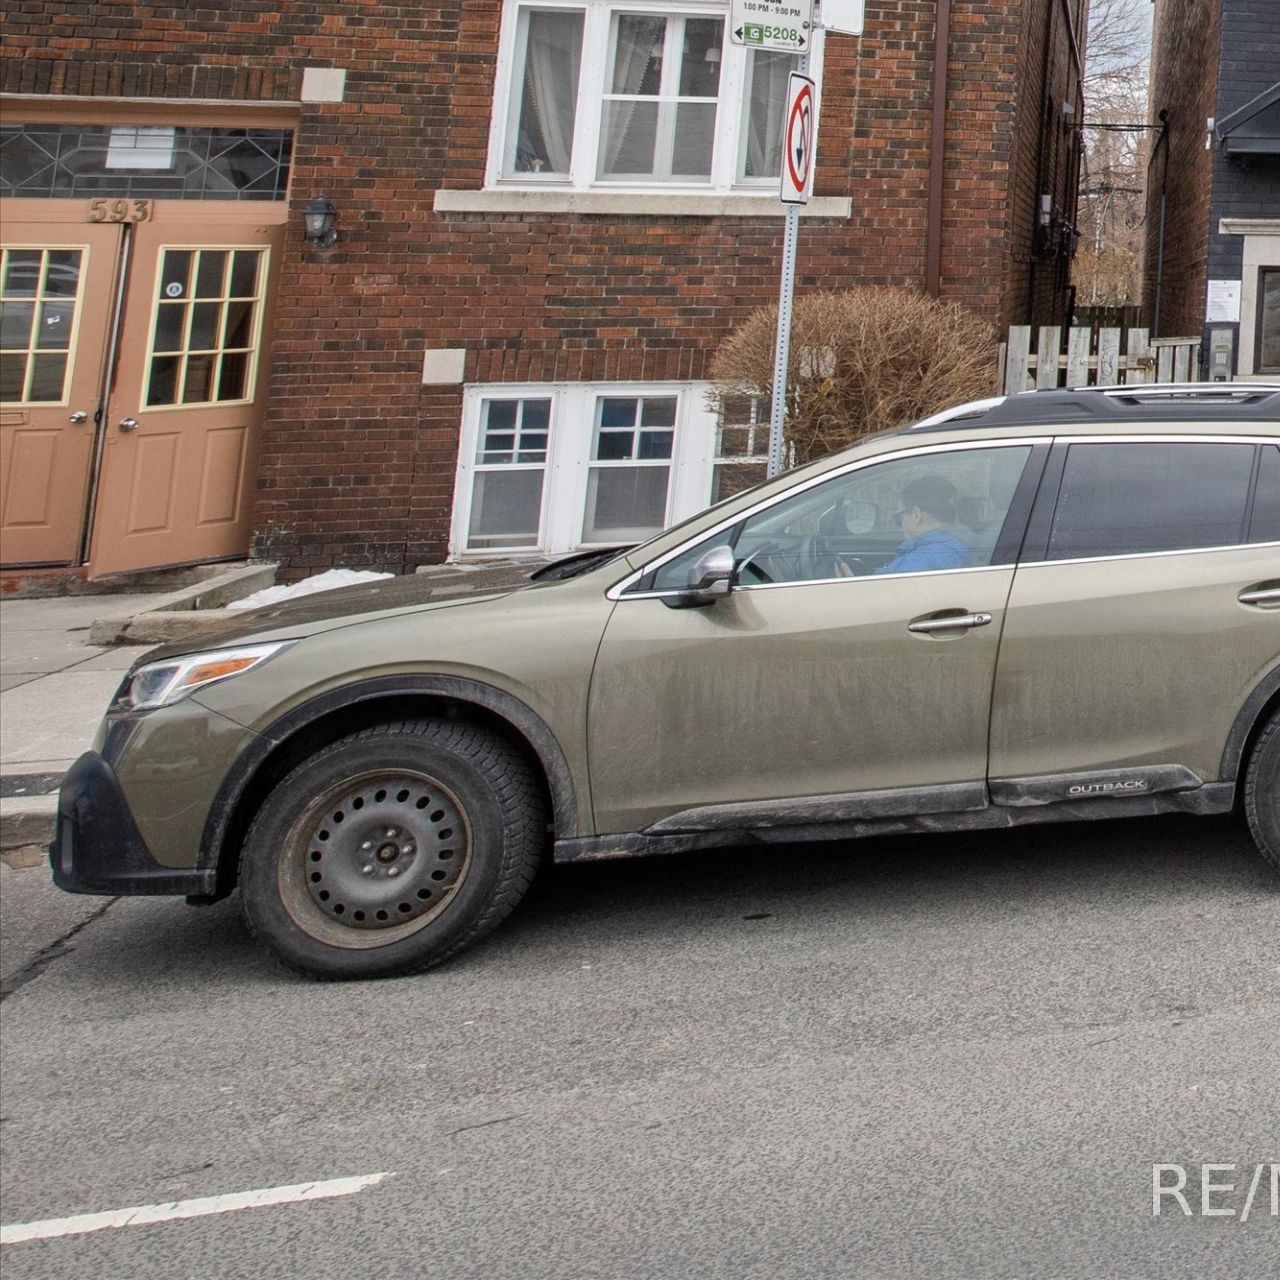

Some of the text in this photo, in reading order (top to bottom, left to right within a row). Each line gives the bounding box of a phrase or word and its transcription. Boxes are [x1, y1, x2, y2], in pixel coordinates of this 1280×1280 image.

[744, 2, 757, 11] 1:00
[757, 4, 769, 13] PM
[775, 6, 789, 16] 9:00
[790, 8, 801, 17] PM
[764, 26, 798, 41] 5208
[89, 199, 149, 223] 593
[1069, 780, 1145, 794] OUTBACK
